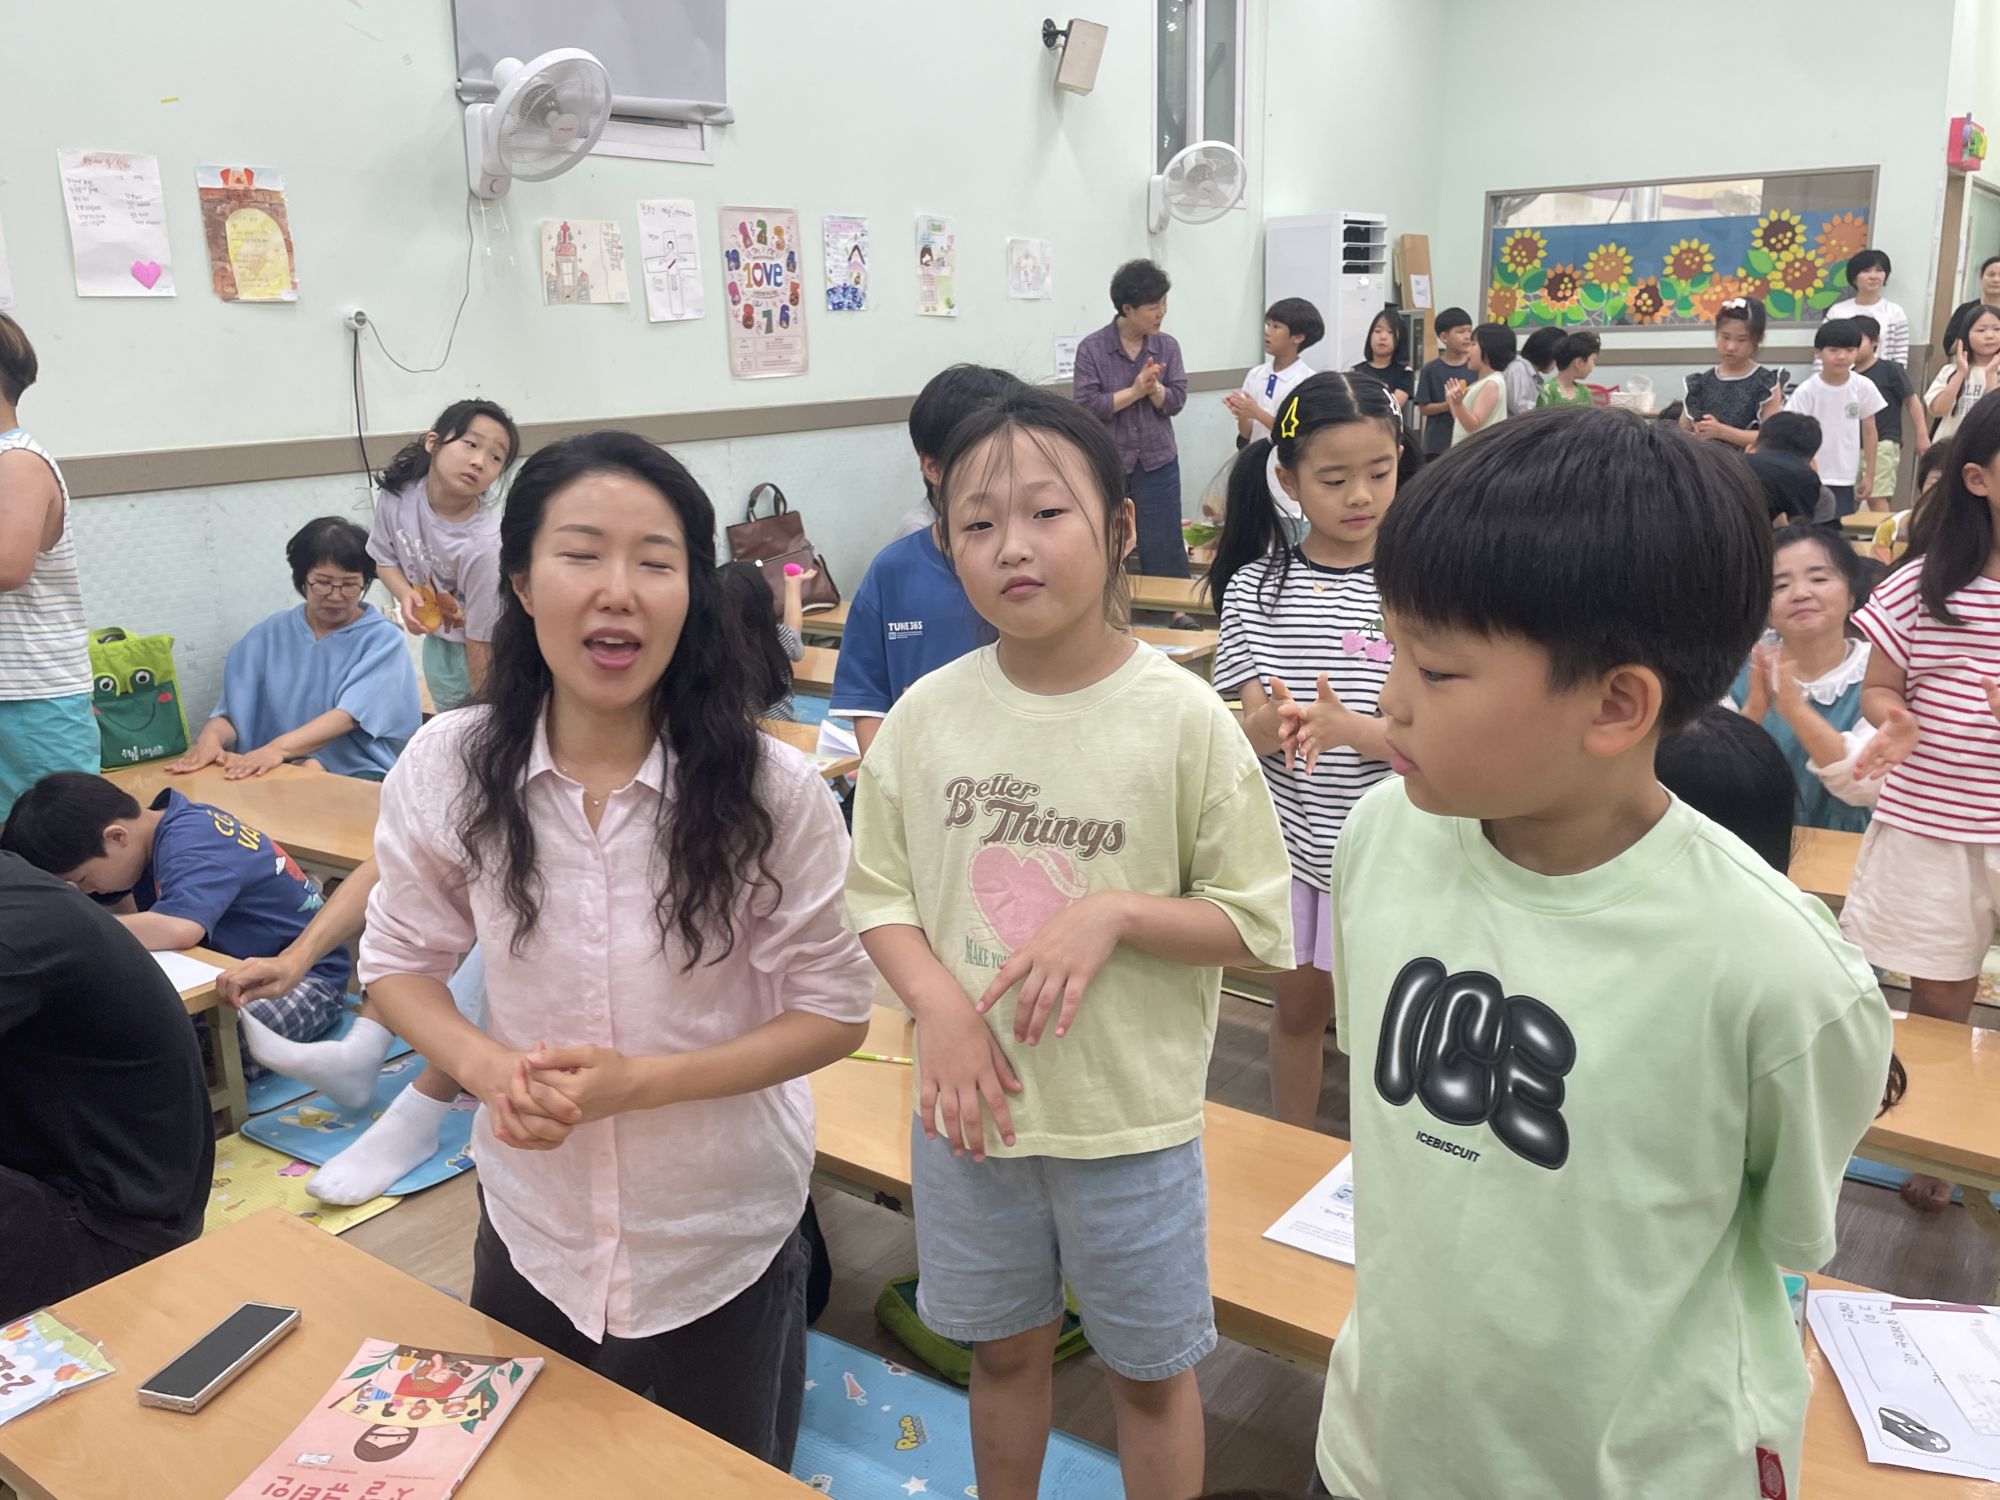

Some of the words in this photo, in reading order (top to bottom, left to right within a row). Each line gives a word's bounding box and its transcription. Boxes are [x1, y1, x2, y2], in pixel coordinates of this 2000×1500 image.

[944, 773, 1040, 830] Better
[982, 798, 1126, 861] Things
[965, 935, 990, 969] MAKE
[1375, 956, 1577, 1171] ICE
[1415, 1130, 1481, 1163] ICEBISCUIT
